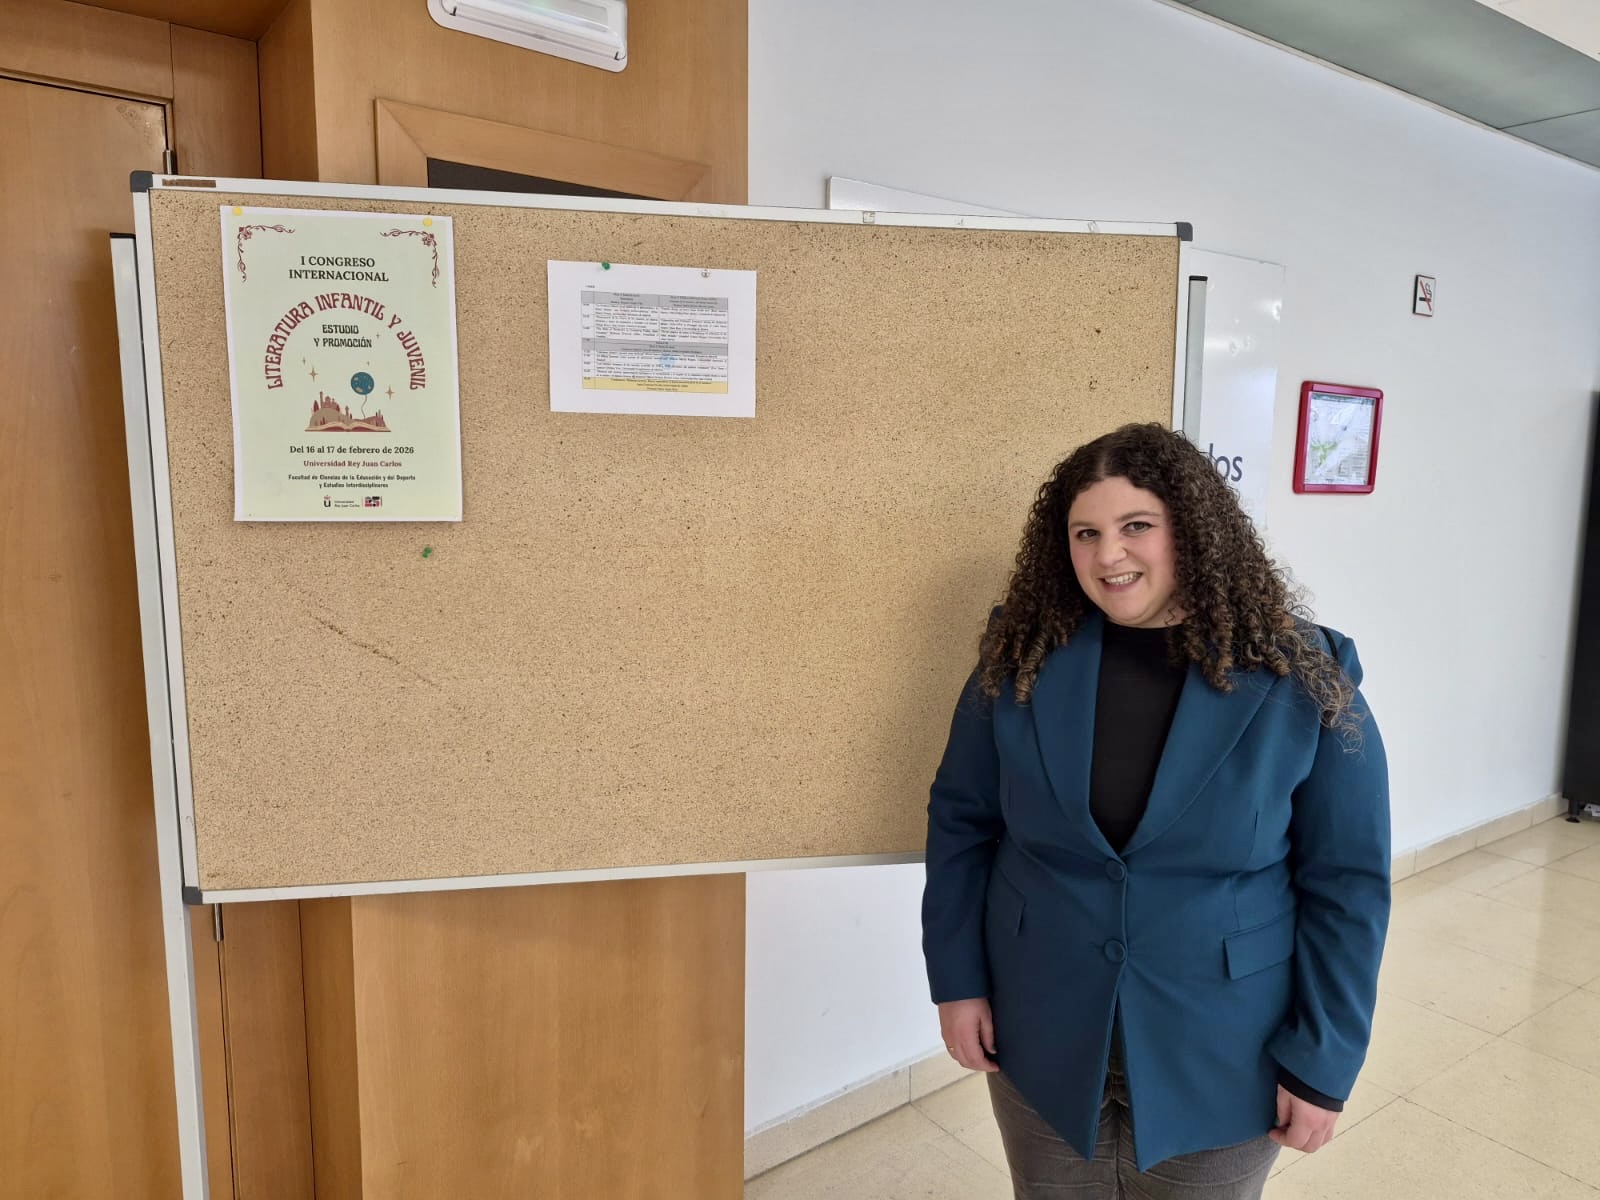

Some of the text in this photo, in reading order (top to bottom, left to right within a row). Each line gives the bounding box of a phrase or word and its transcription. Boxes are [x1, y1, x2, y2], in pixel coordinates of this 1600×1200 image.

[301, 256, 376, 268] I CONGRESO
[289, 269, 389, 282] INTERNACIONAL
[322, 324, 360, 335] ESTUDIO
[264, 292, 426, 391] LITERATURA INFANTIL Y JUVENIL
[313, 336, 372, 348] Y PROMOCIÓN
[289, 445, 415, 454] Del 16 al 17 de febrero de 2026
[303, 460, 346, 468] Universidad
[347, 460, 360, 468] Rey
